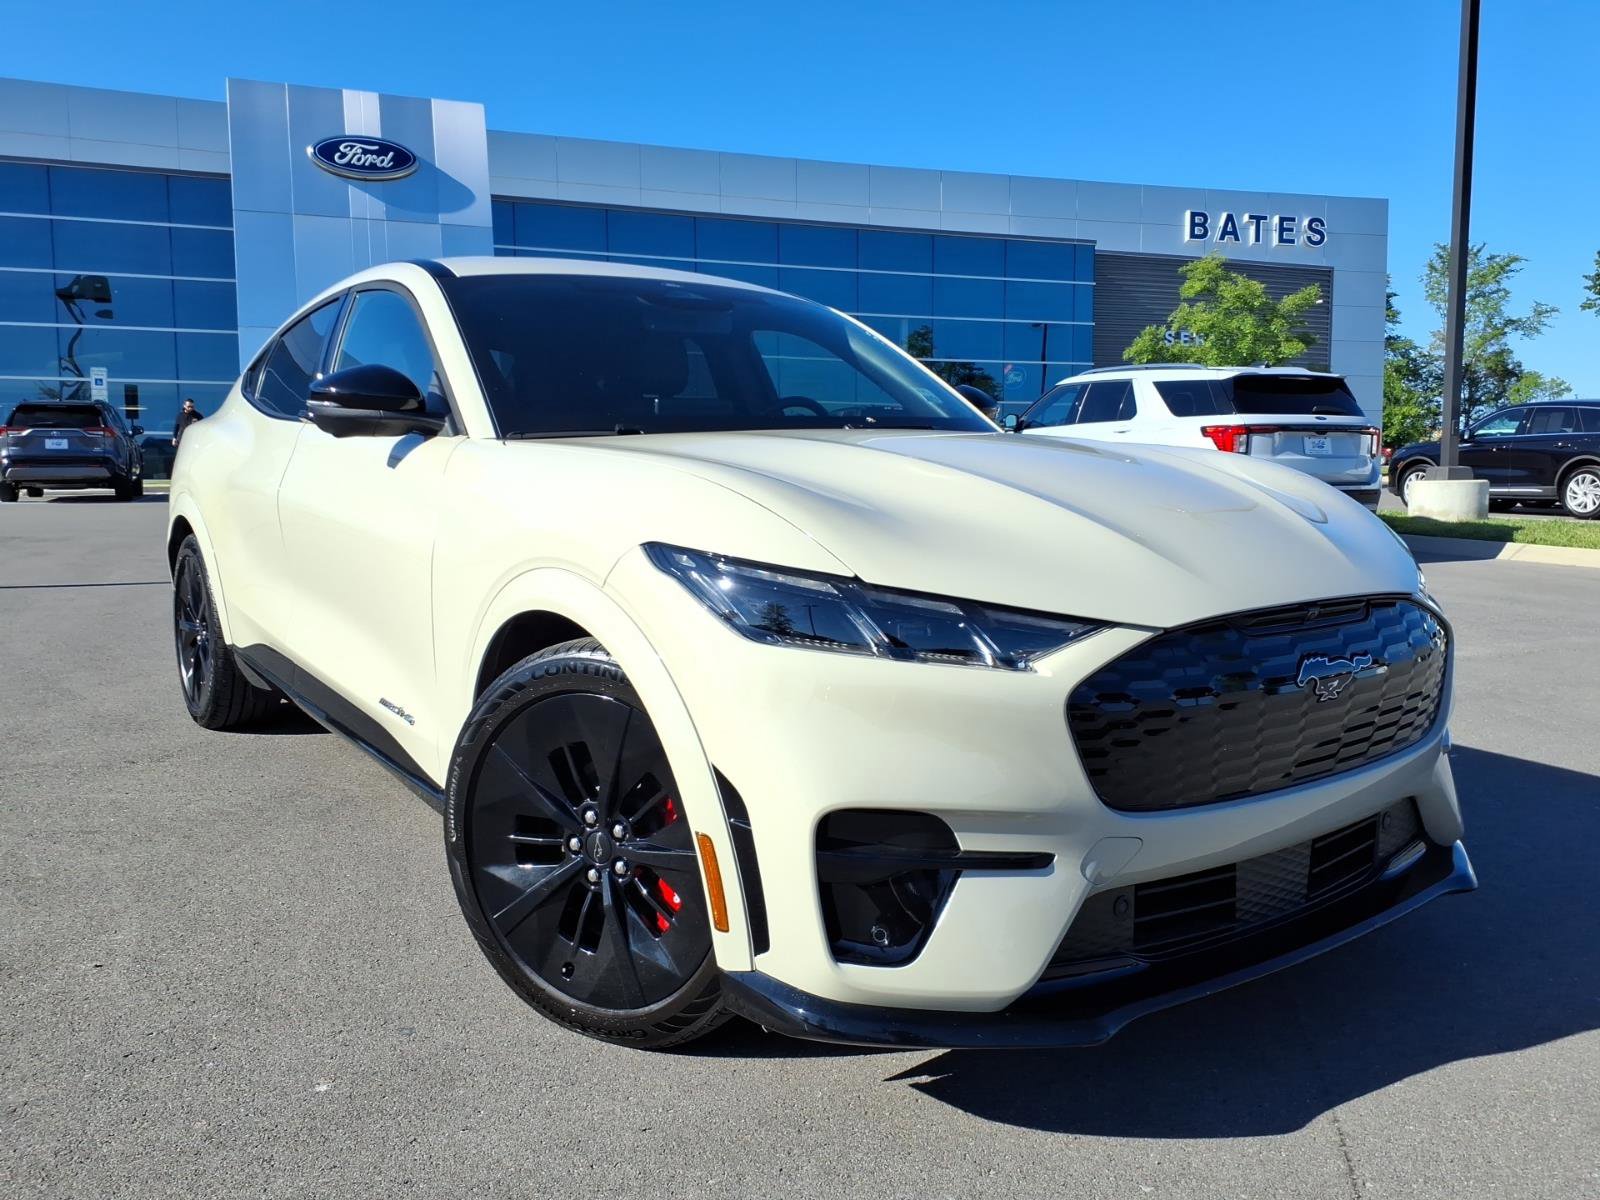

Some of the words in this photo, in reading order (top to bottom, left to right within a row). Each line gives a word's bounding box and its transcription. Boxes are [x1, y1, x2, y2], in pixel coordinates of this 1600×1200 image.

[334, 141, 394, 168] Ford
[1184, 209, 1328, 247] BATES
[1164, 330, 1205, 347] SER
[530, 661, 625, 684] CONTIN
